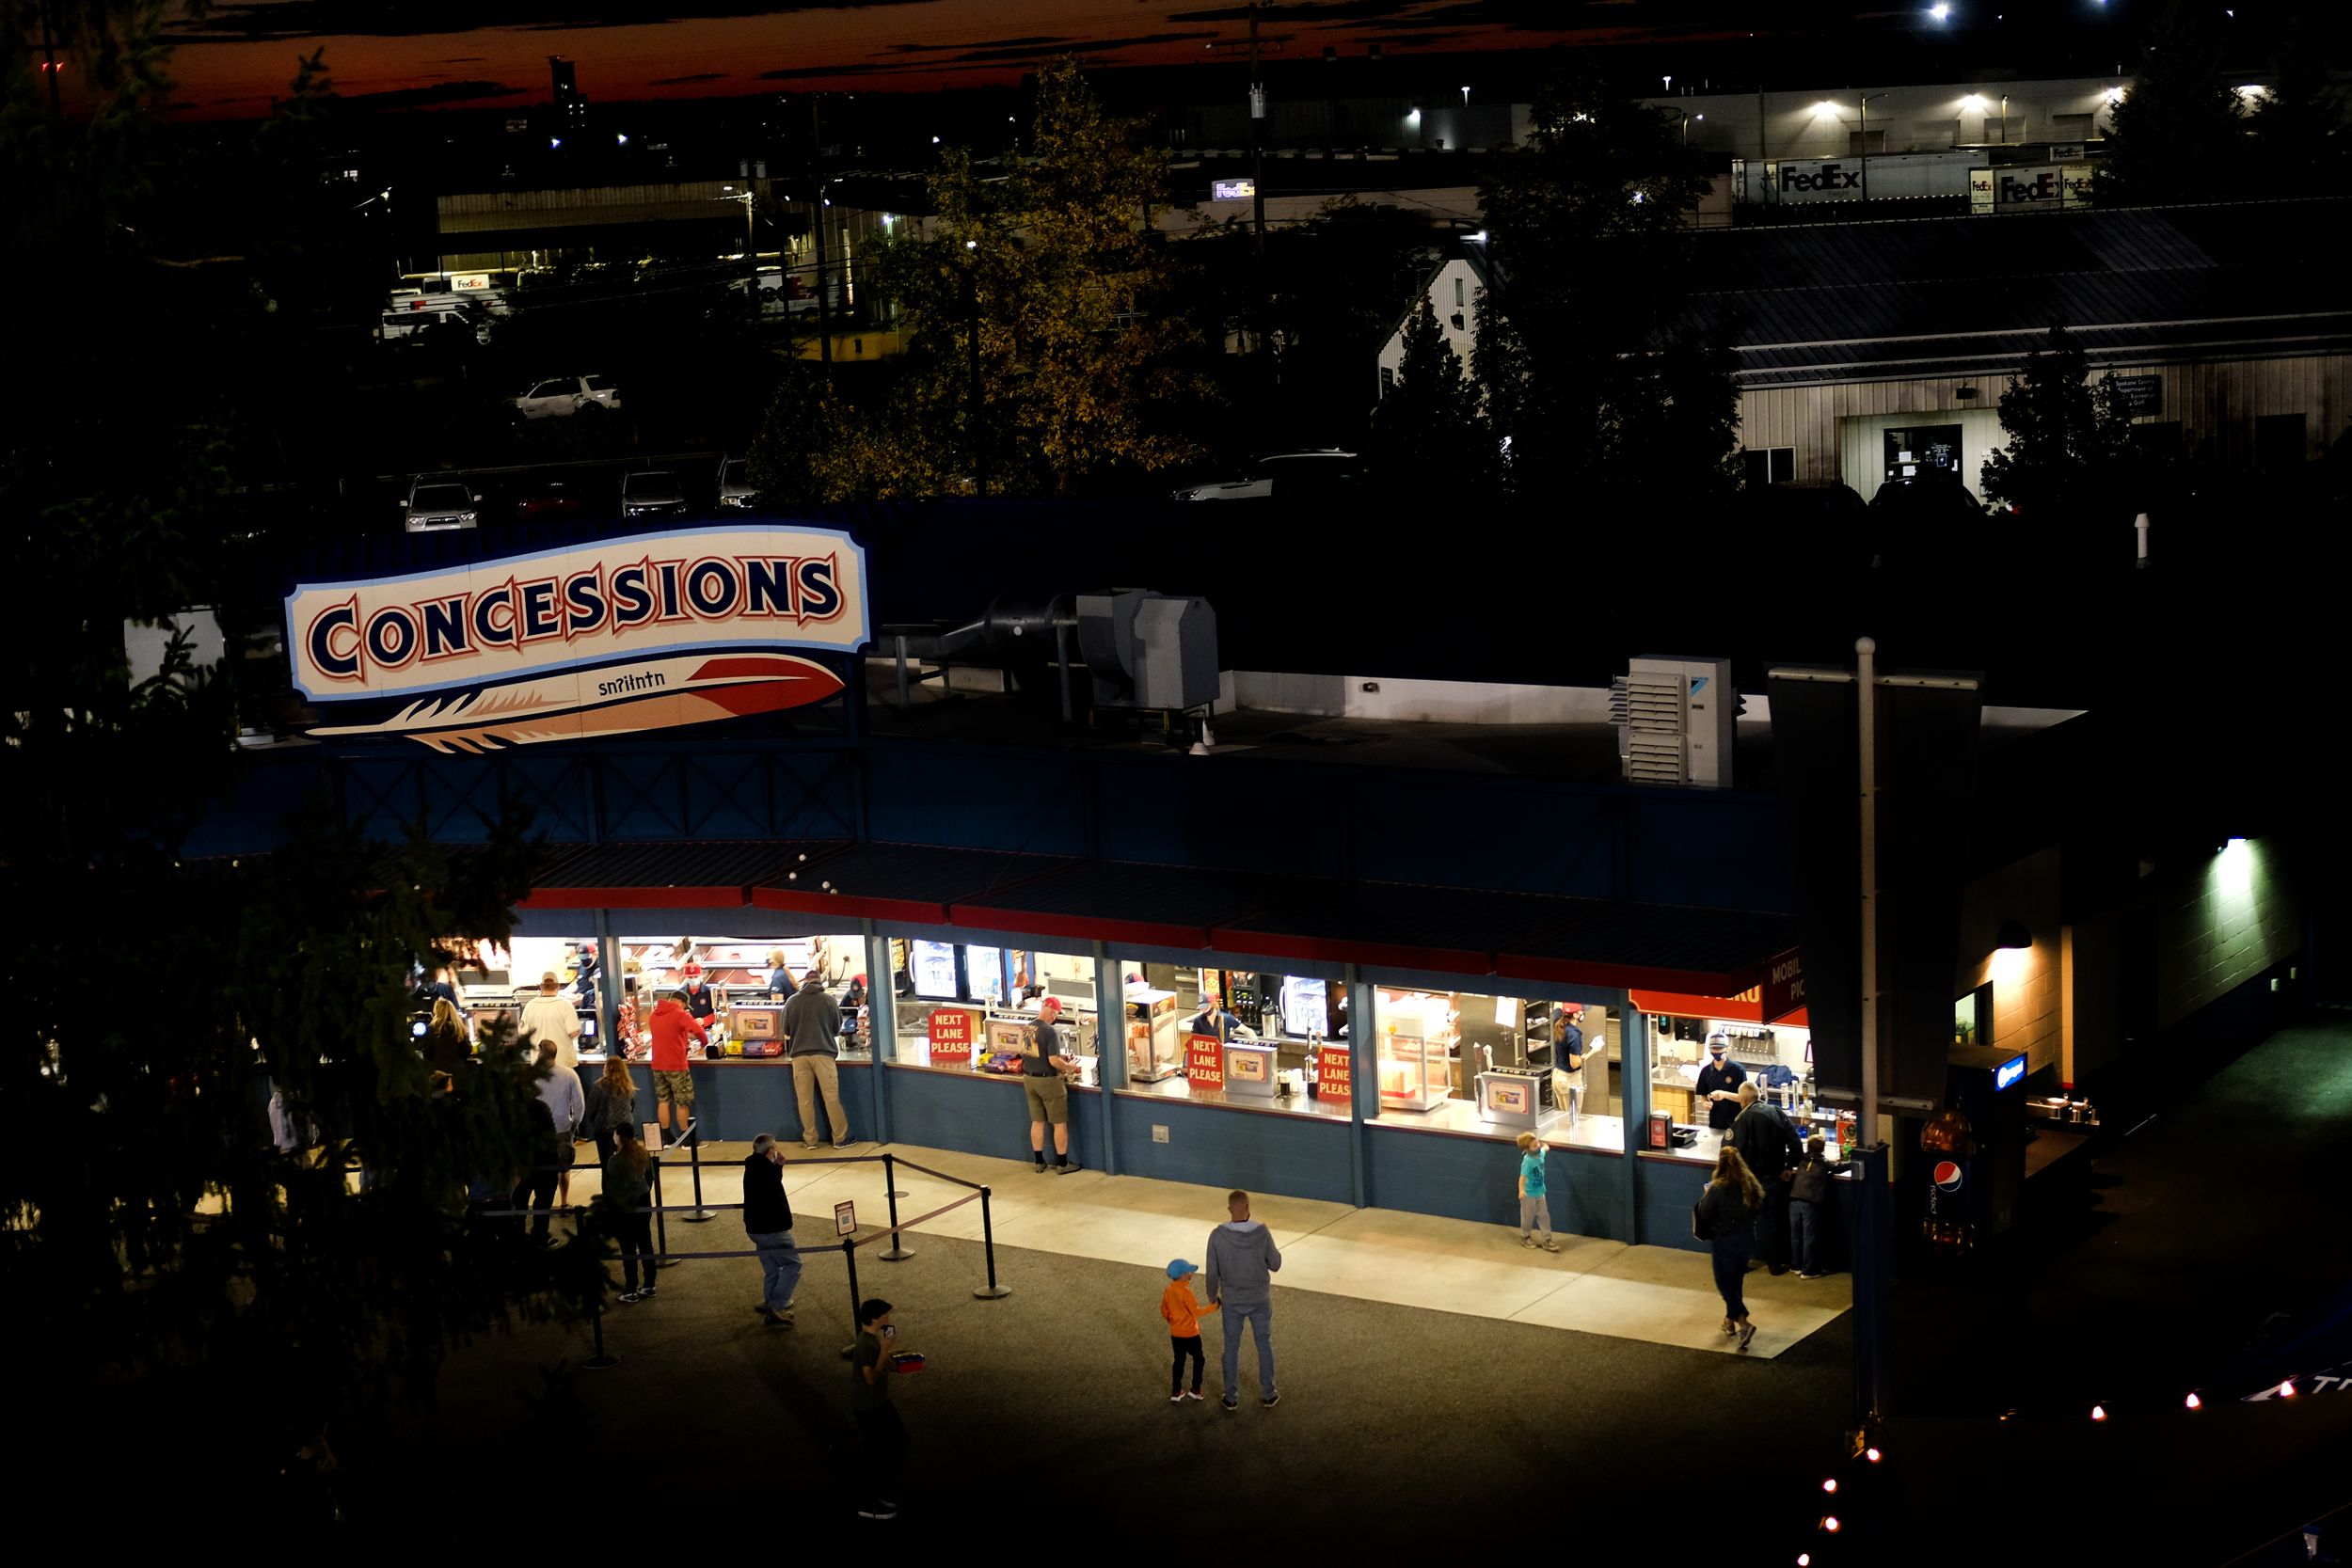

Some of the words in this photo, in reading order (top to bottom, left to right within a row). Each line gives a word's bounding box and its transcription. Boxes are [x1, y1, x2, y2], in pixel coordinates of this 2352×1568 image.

[1782, 165, 1860, 192] FedEx
[1972, 181, 1992, 192] FedEx
[457, 280, 483, 289] FedEx
[306, 552, 845, 684] CONCESSIONS
[1772, 957, 1803, 986] MOBIL
[1790, 978, 1806, 1001] PIC
[935, 1015, 963, 1025] NEXT
[936, 1028, 964, 1039] LANE
[931, 1042, 970, 1053] PLEASE
[1193, 1039, 1216, 1053] NEXT
[1193, 1053, 1216, 1068] LANE
[1324, 1053, 1350, 1067] NEXT
[1189, 1068, 1221, 1083] PLEASE
[1324, 1068, 1350, 1081] LANE
[1319, 1082, 1350, 1096] PLEAS
